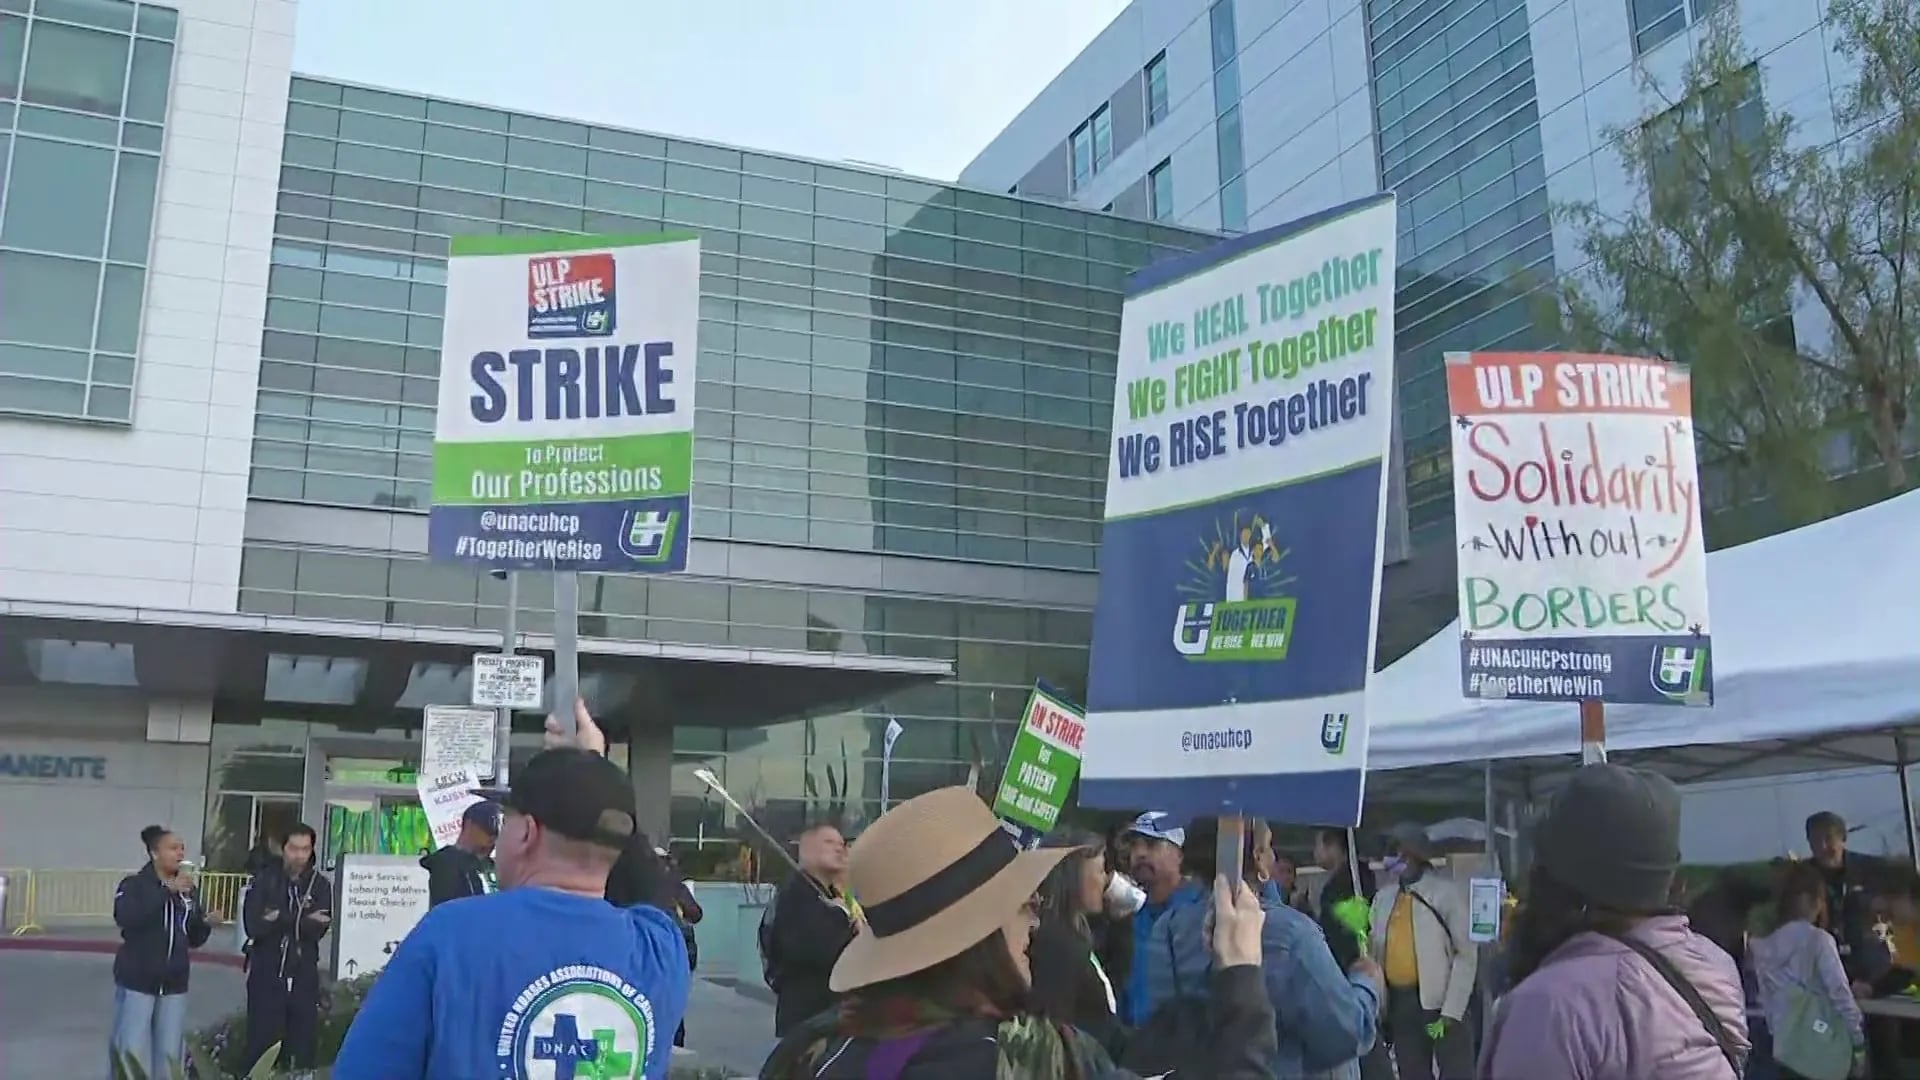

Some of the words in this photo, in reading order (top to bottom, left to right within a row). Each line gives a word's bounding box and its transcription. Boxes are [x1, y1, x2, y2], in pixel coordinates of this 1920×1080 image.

[532, 259, 569, 288] ULP
[534, 279, 605, 312] STRIKE
[1148, 320, 1185, 362] We
[1194, 294, 1248, 349] HEAL
[1257, 248, 1382, 325] Together
[1128, 377, 1166, 420] We
[1175, 348, 1241, 408] FIGHT
[1247, 307, 1377, 384] Together
[469, 341, 677, 423] STRIKE
[1475, 363, 1544, 408] ULP
[1554, 363, 1670, 409] STRIKE
[1118, 433, 1160, 478] We
[1169, 410, 1227, 467] RISE
[1233, 372, 1371, 447] Together
[526, 447, 541, 465] To
[547, 443, 604, 463] Protect
[472, 471, 511, 498] Our
[520, 464, 663, 497] Professions
[1468, 421, 1693, 579] Solidarity
[480, 510, 580, 535] @unacuhcp
[456, 535, 602, 560] #TogetherWeRise
[1216, 608, 1286, 632] TOGETHER
[1465, 577, 1687, 633] BORDERS
[1469, 647, 1611, 672] #UNACUHCPstrong
[1469, 672, 1602, 696] #TogetherWeWin
[1031, 701, 1047, 729] ON
[1046, 711, 1085, 750] STRIKE
[1182, 727, 1252, 751] @unacuhcp
[1018, 761, 1057, 795] PATIENT
[497, 1011, 519, 1056] UNITED
[512, 975, 551, 1013] NURSES
[543, 1042, 588, 1057] UNAC
